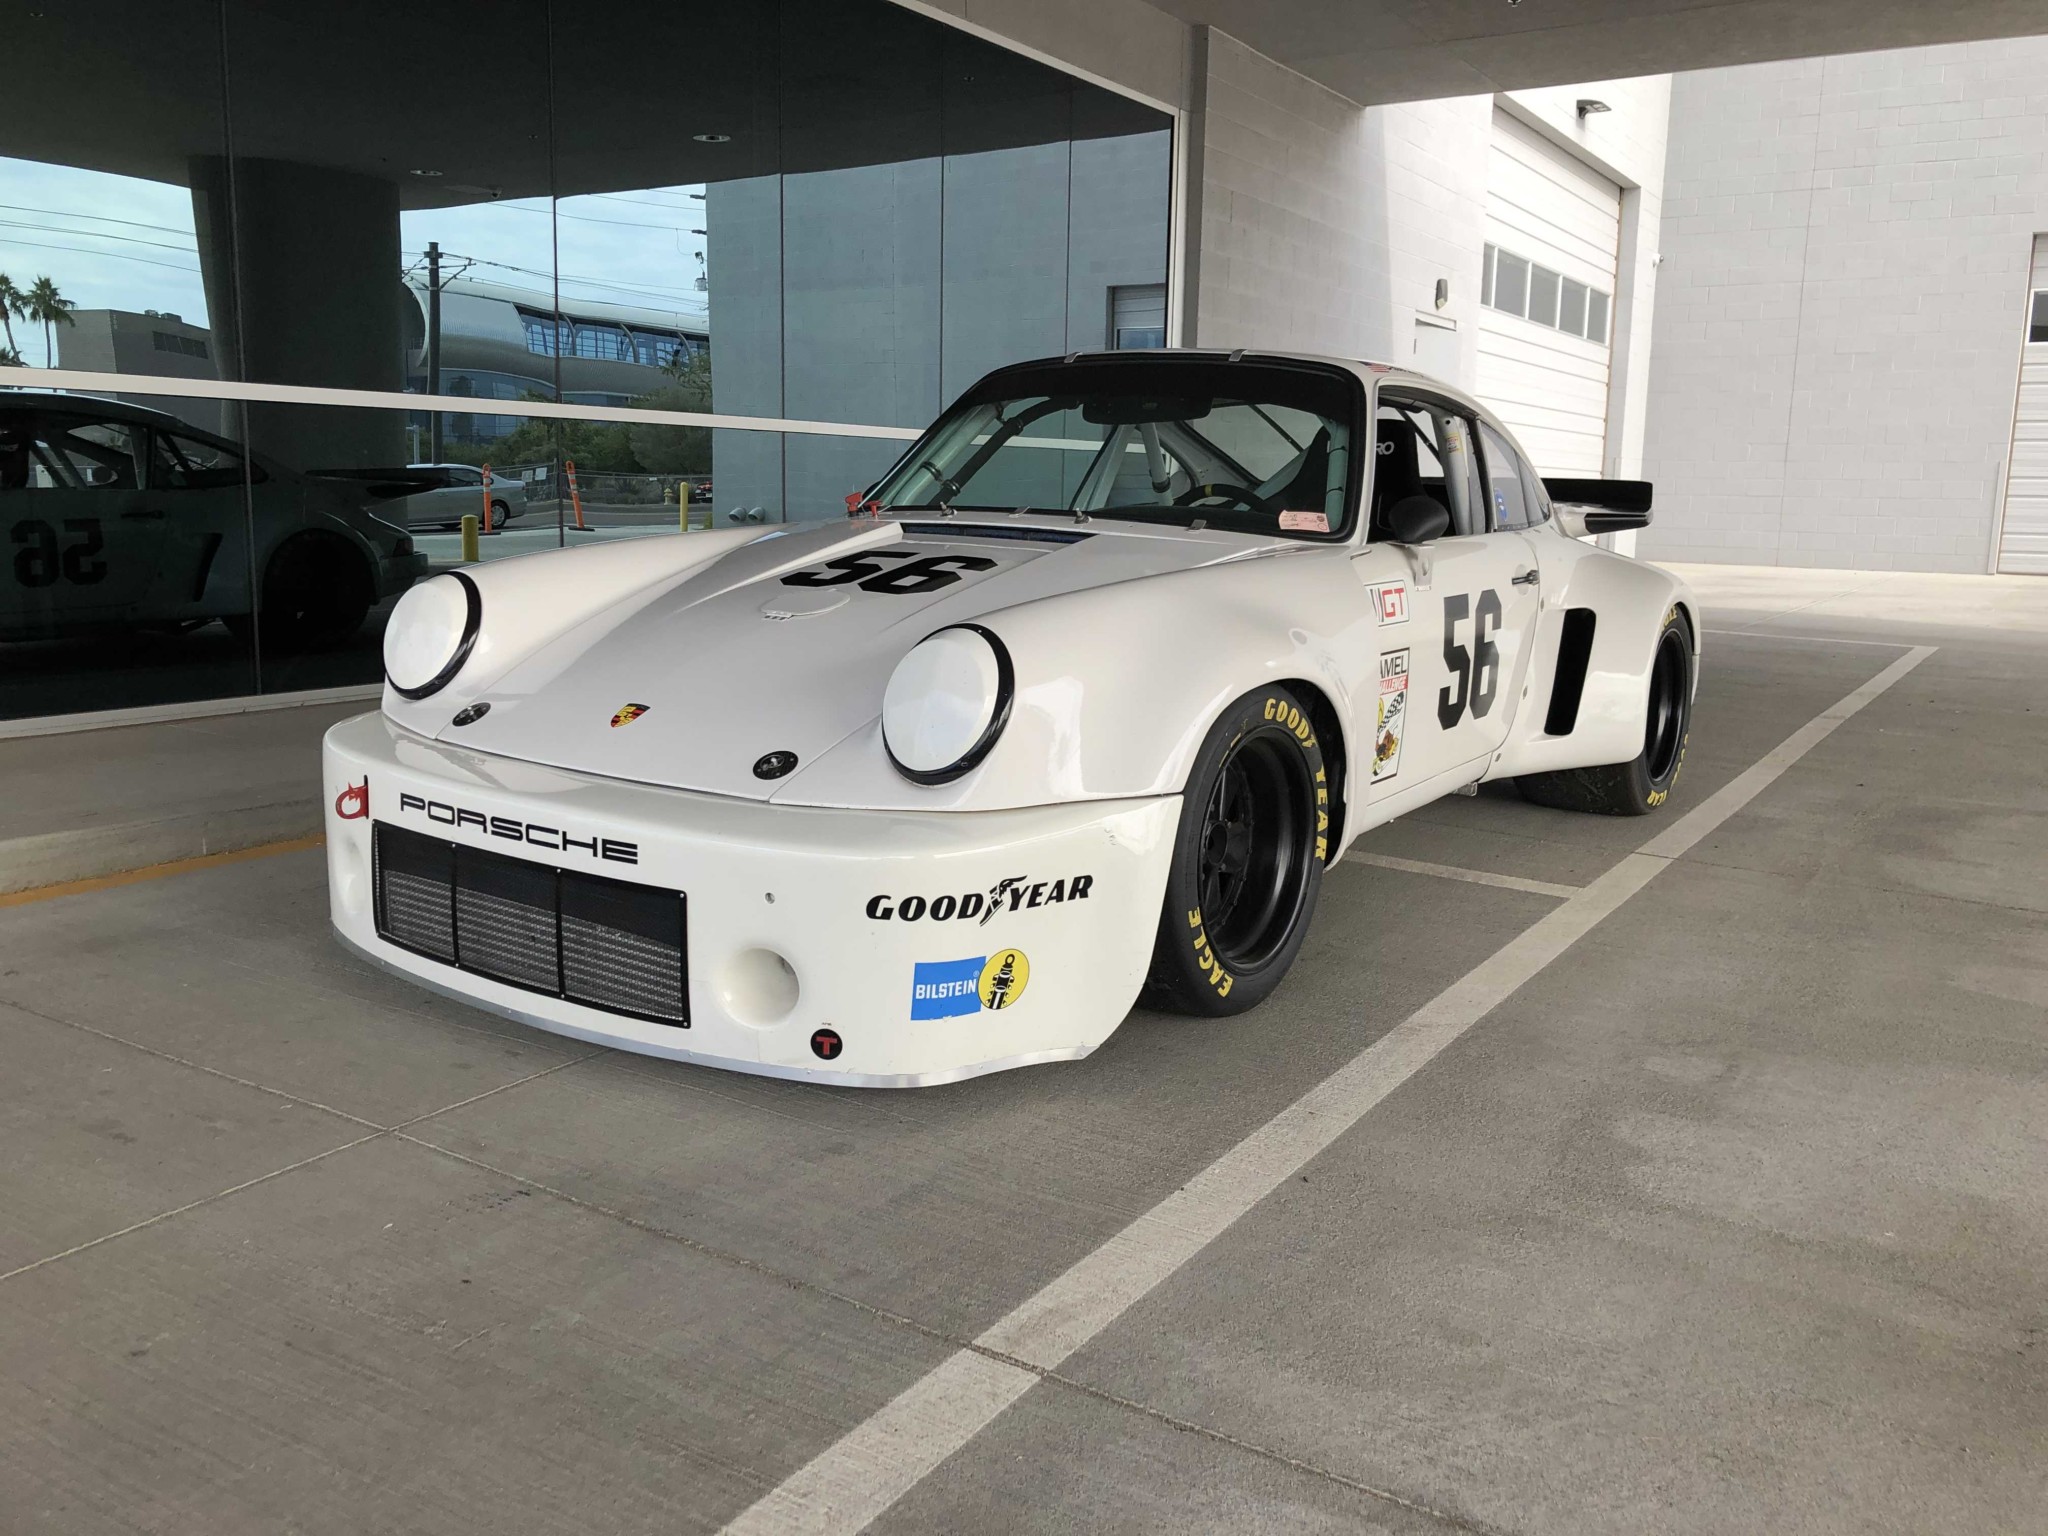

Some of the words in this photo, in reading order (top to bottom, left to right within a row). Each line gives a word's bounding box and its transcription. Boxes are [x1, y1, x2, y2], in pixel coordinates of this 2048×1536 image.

[779, 550, 998, 595] 56
[1382, 587, 1405, 618] GT
[1437, 588, 1503, 731] 56
[400, 792, 638, 865] PORSCHE
[1188, 906, 1234, 998] EAGLE
[915, 978, 977, 1000] BILSTEIN
